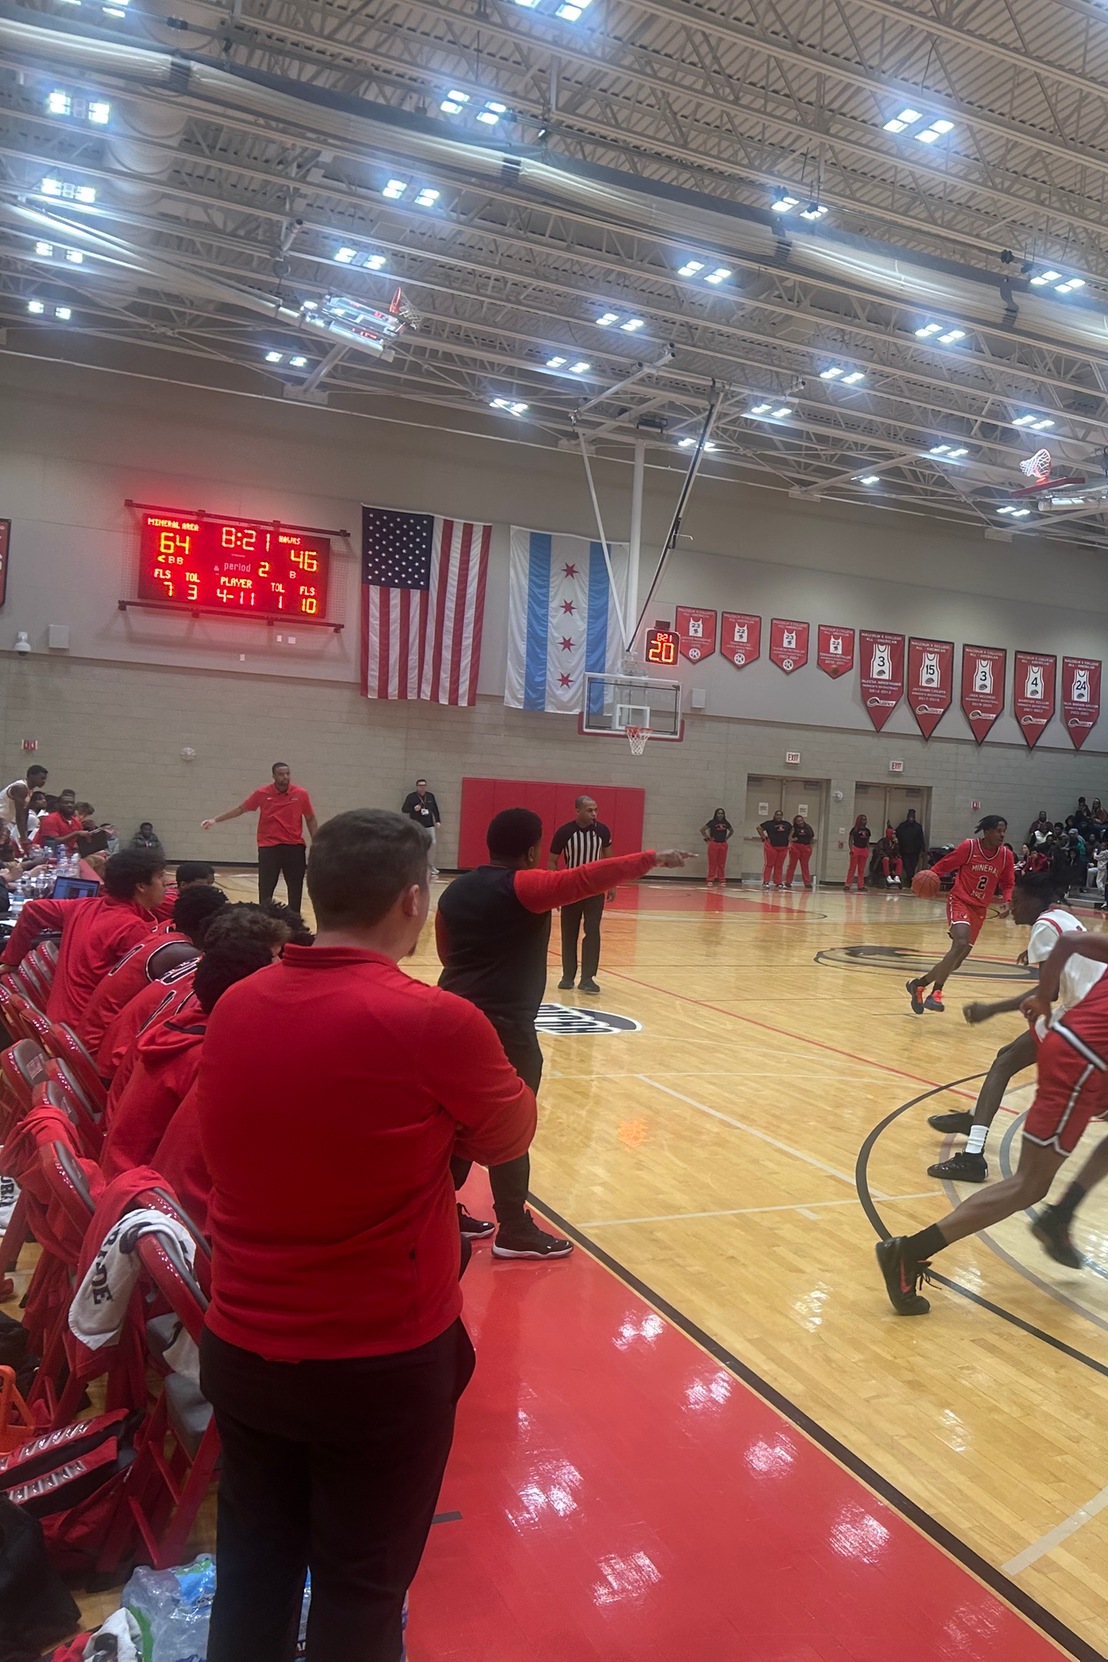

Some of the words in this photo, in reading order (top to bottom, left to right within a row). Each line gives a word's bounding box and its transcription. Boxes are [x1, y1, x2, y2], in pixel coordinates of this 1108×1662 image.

[181, 521, 199, 531] AREA
[160, 532, 189, 554] 64
[290, 549, 317, 572] 46
[223, 562, 251, 572] period
[258, 562, 269, 577] 2
[154, 569, 171, 579] FLS
[185, 572, 200, 582] TOL
[220, 577, 252, 589] PLAYER
[271, 583, 285, 593] TOL
[163, 582, 173, 597] 7
[187, 585, 198, 600] 3
[300, 586, 316, 596] FLS
[278, 595, 283, 609] 1
[301, 598, 317, 614] 10
[648, 640, 675, 663] 20
[877, 656, 885, 667] 3
[925, 664, 935, 675] 15
[979, 671, 987, 682] 3
[1031, 677, 1038, 687] 4
[1075, 680, 1086, 691] 24
[976, 875, 989, 890] 2
